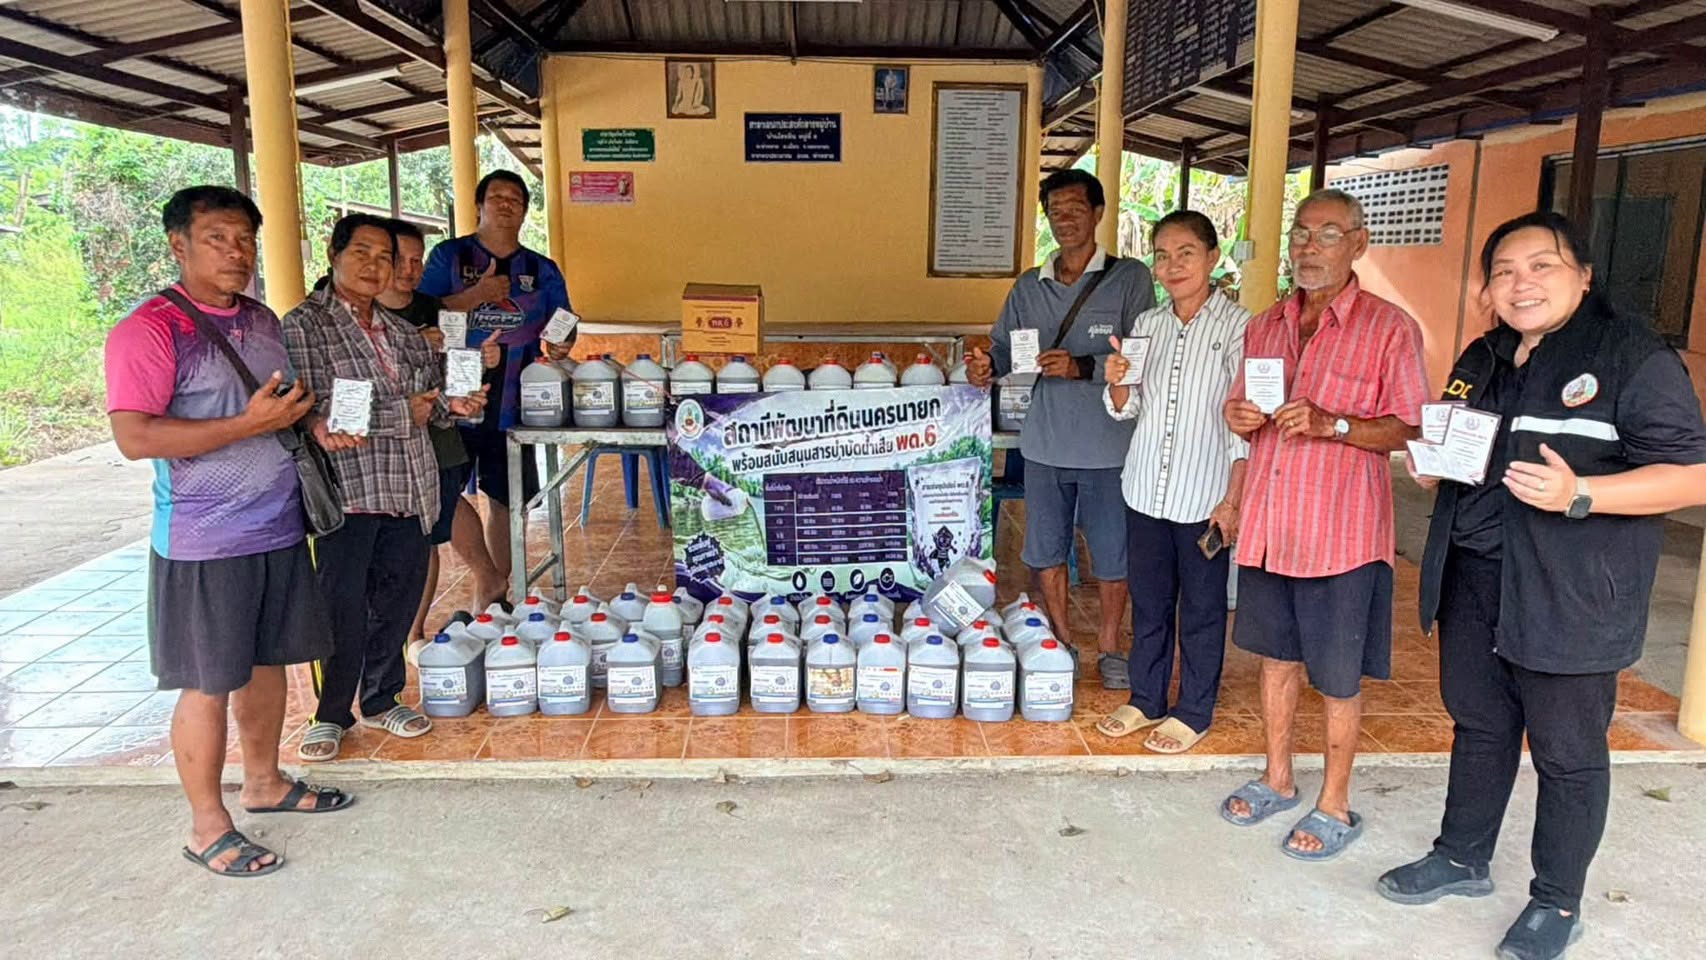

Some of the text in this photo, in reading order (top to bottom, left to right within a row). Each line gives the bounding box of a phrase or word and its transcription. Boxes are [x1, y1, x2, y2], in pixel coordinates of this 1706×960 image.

[724, 398, 941, 446] สถานีพัฒนาที่ดินนครนายก
[732, 424, 937, 472] พร้อมสนับสนุนสารบำบัดน้ำเสีย พด.6
